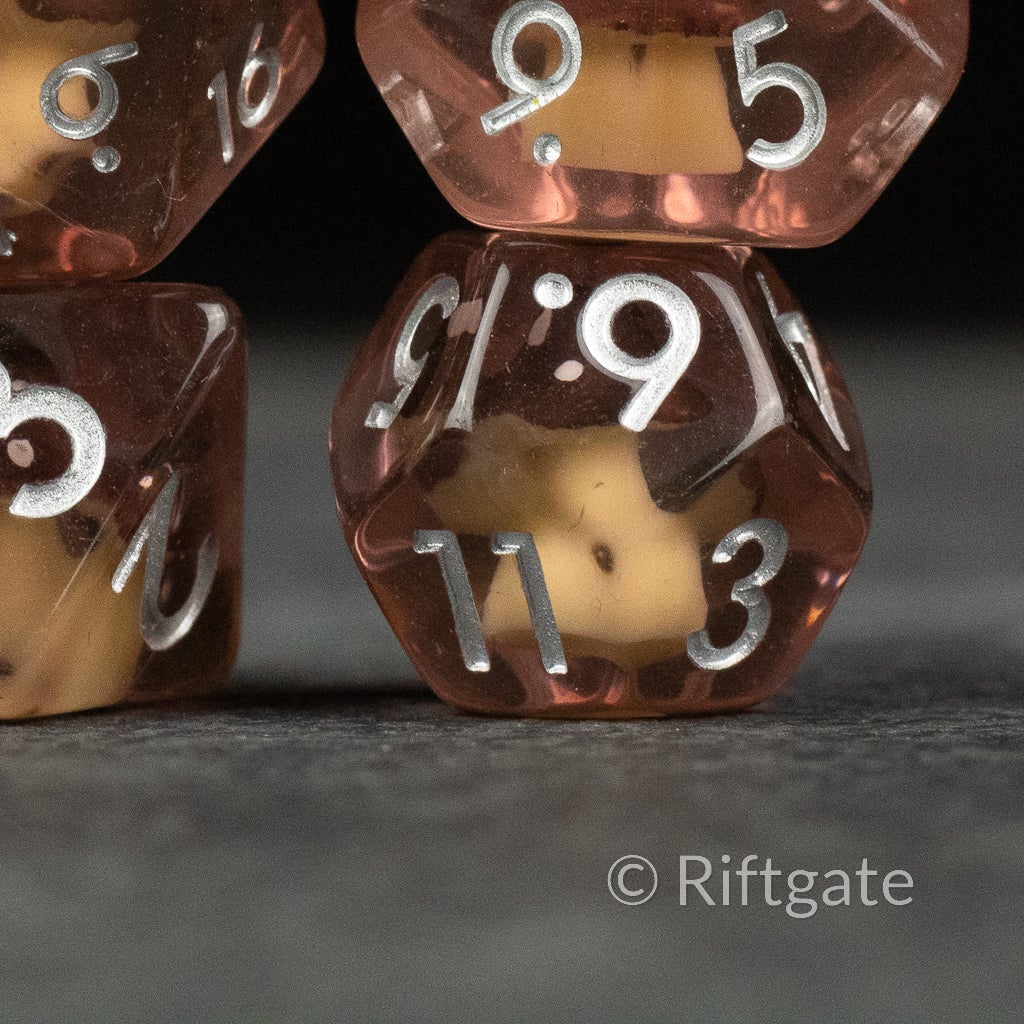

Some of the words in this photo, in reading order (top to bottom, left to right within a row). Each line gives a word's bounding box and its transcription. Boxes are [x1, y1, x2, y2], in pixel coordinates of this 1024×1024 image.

[206, 22, 283, 165] 16
[732, 8, 827, 171] 5
[413, 529, 569, 675] 11
[686, 517, 790, 671] 3
